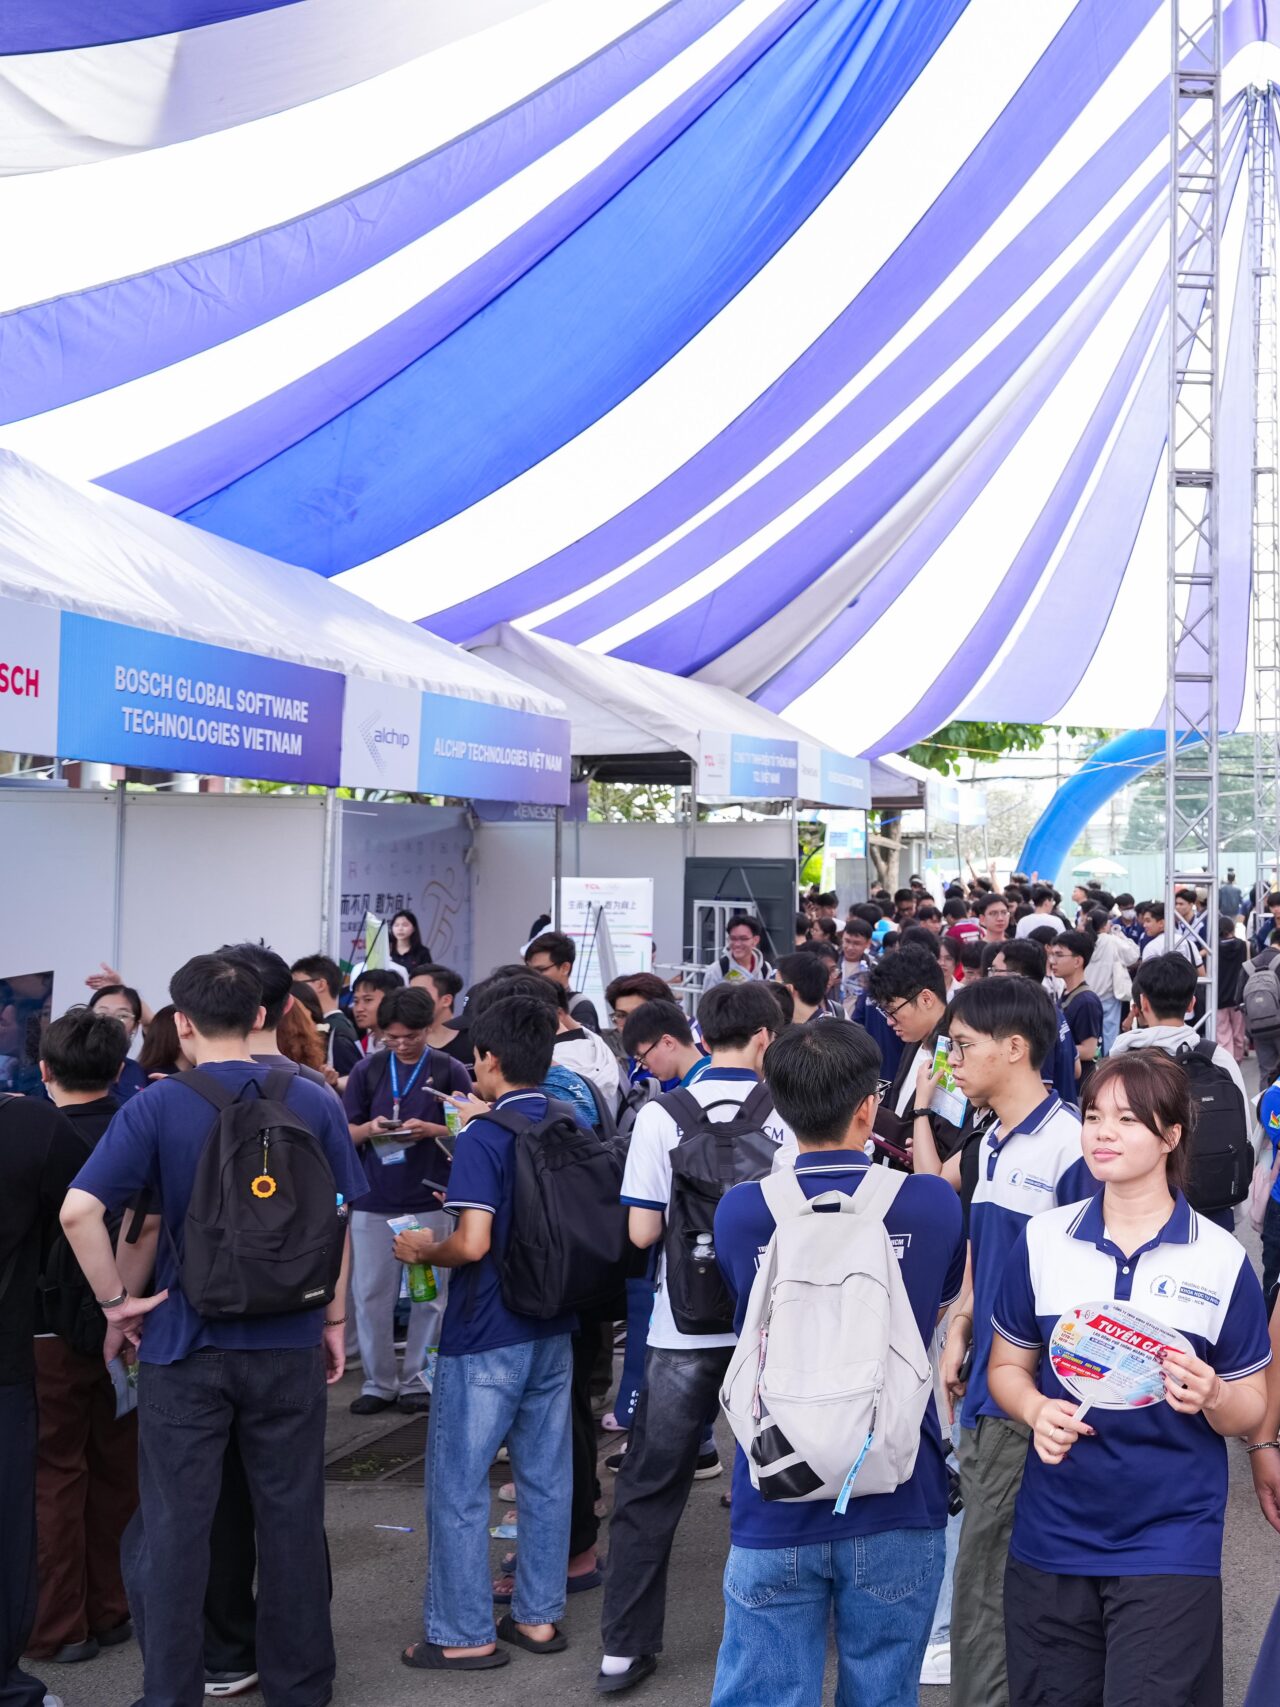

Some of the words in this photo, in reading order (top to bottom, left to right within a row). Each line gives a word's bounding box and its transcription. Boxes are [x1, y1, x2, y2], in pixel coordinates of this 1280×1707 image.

[0, 663, 39, 697] SCH
[115, 665, 173, 700] BOSCH
[176, 678, 234, 711] GLOBAL
[236, 691, 309, 723] SOFTWARE
[122, 707, 240, 747] TECHNOLOGIES
[243, 727, 302, 756] VIETNAM
[374, 728, 410, 748] alchip
[434, 737, 466, 759] ALCHIP
[467, 742, 528, 767] TECHNOLOGIES
[529, 747, 546, 773] VIỆT
[546, 756, 562, 772] NAM
